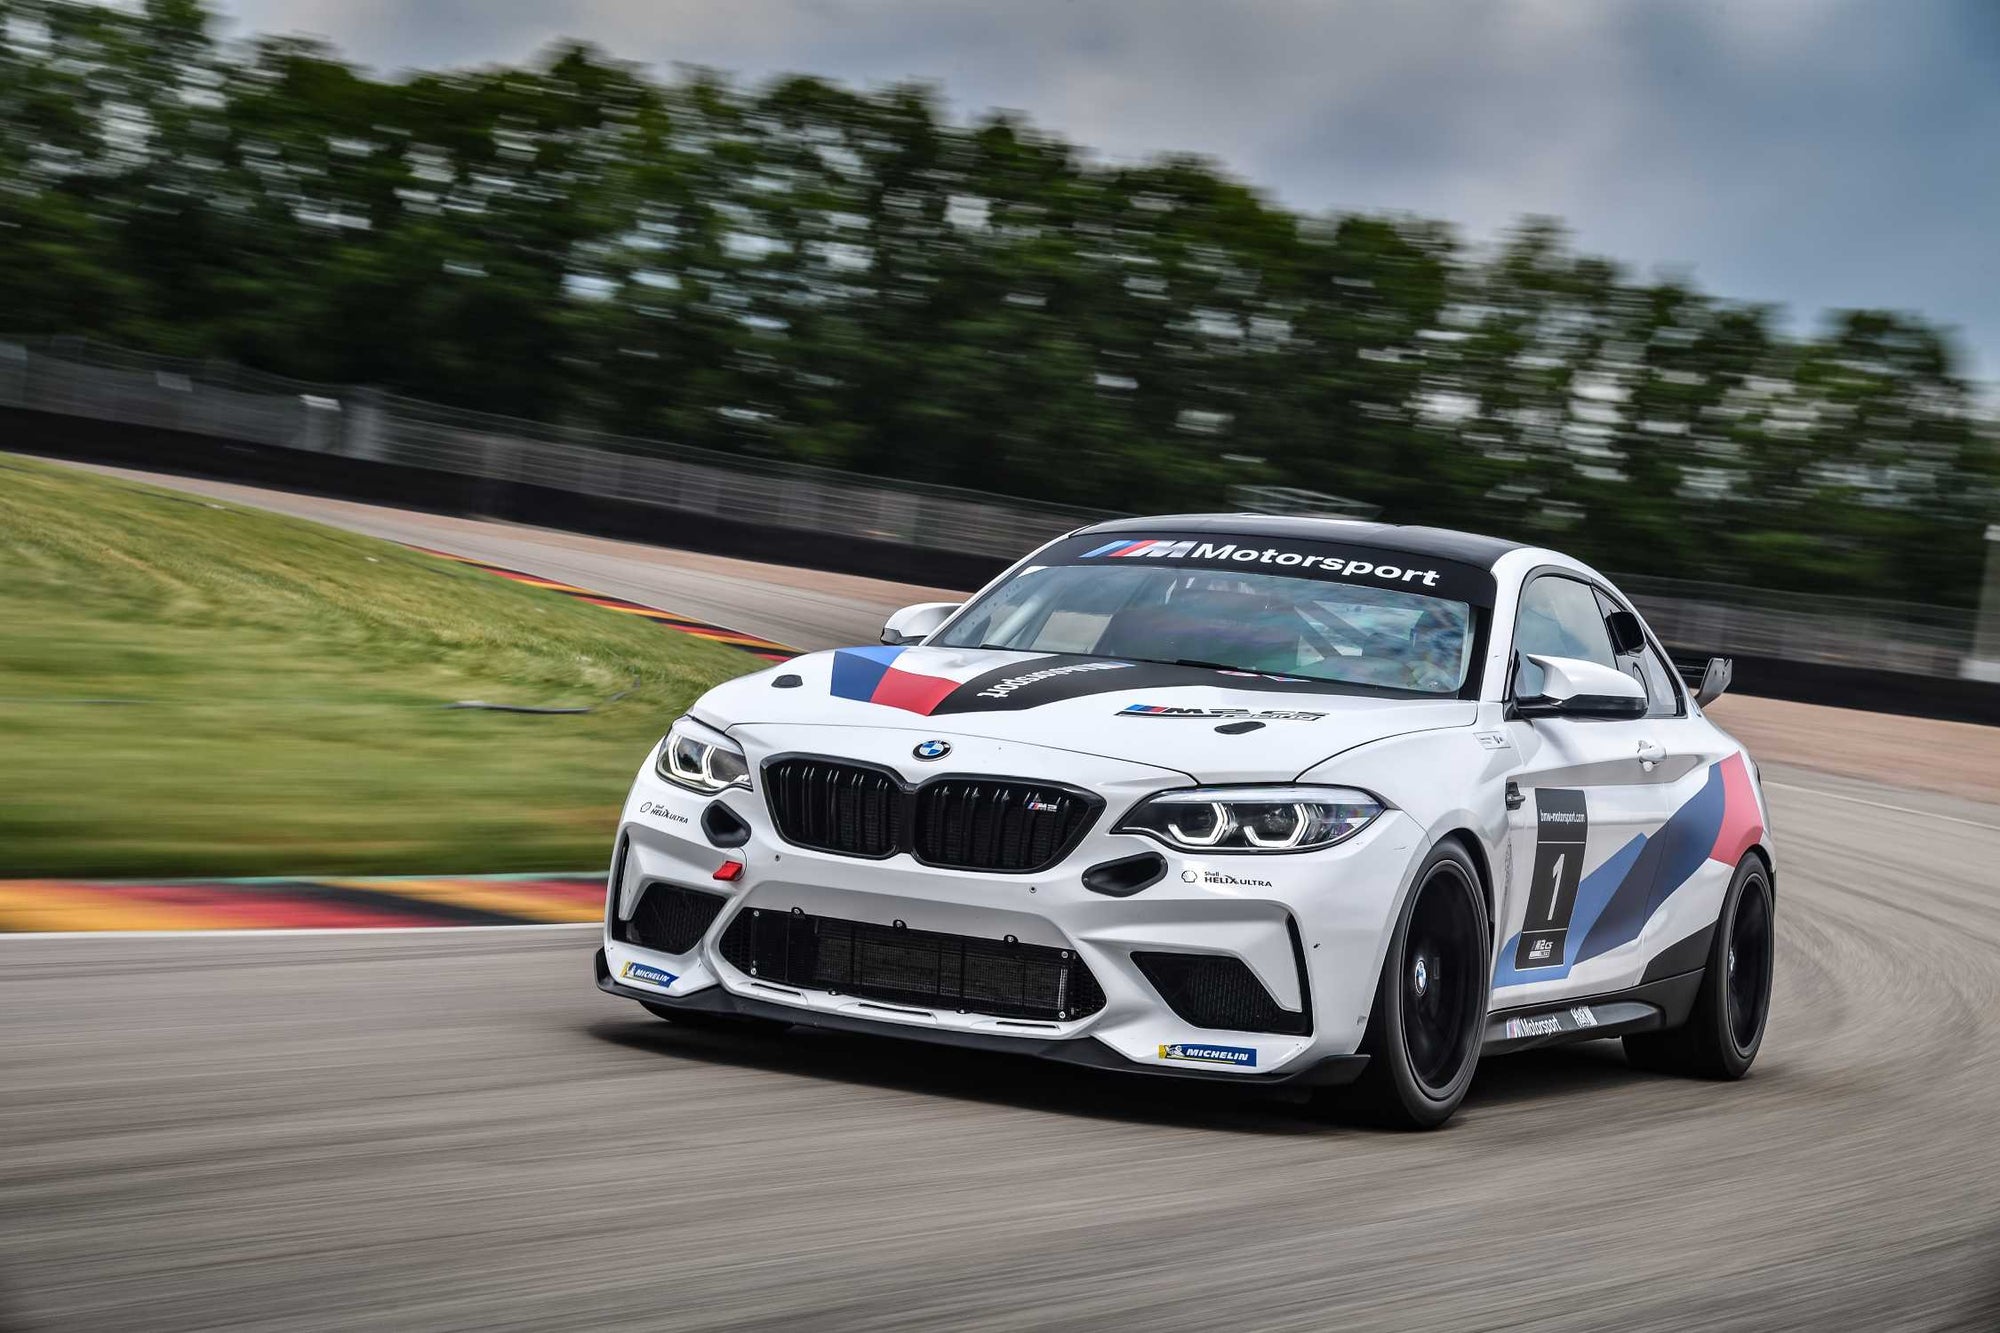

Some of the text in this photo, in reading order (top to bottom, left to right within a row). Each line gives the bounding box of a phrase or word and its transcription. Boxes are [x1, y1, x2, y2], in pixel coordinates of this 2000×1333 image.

[1191, 543, 1440, 587] Motorsport
[1204, 874, 1273, 888] HELIX ULTRA
[1547, 853, 1565, 921] 1
[635, 968, 670, 982] MICHELIN
[1521, 1015, 1562, 1036] Motorsport
[1186, 1048, 1249, 1061] MICHELIN
